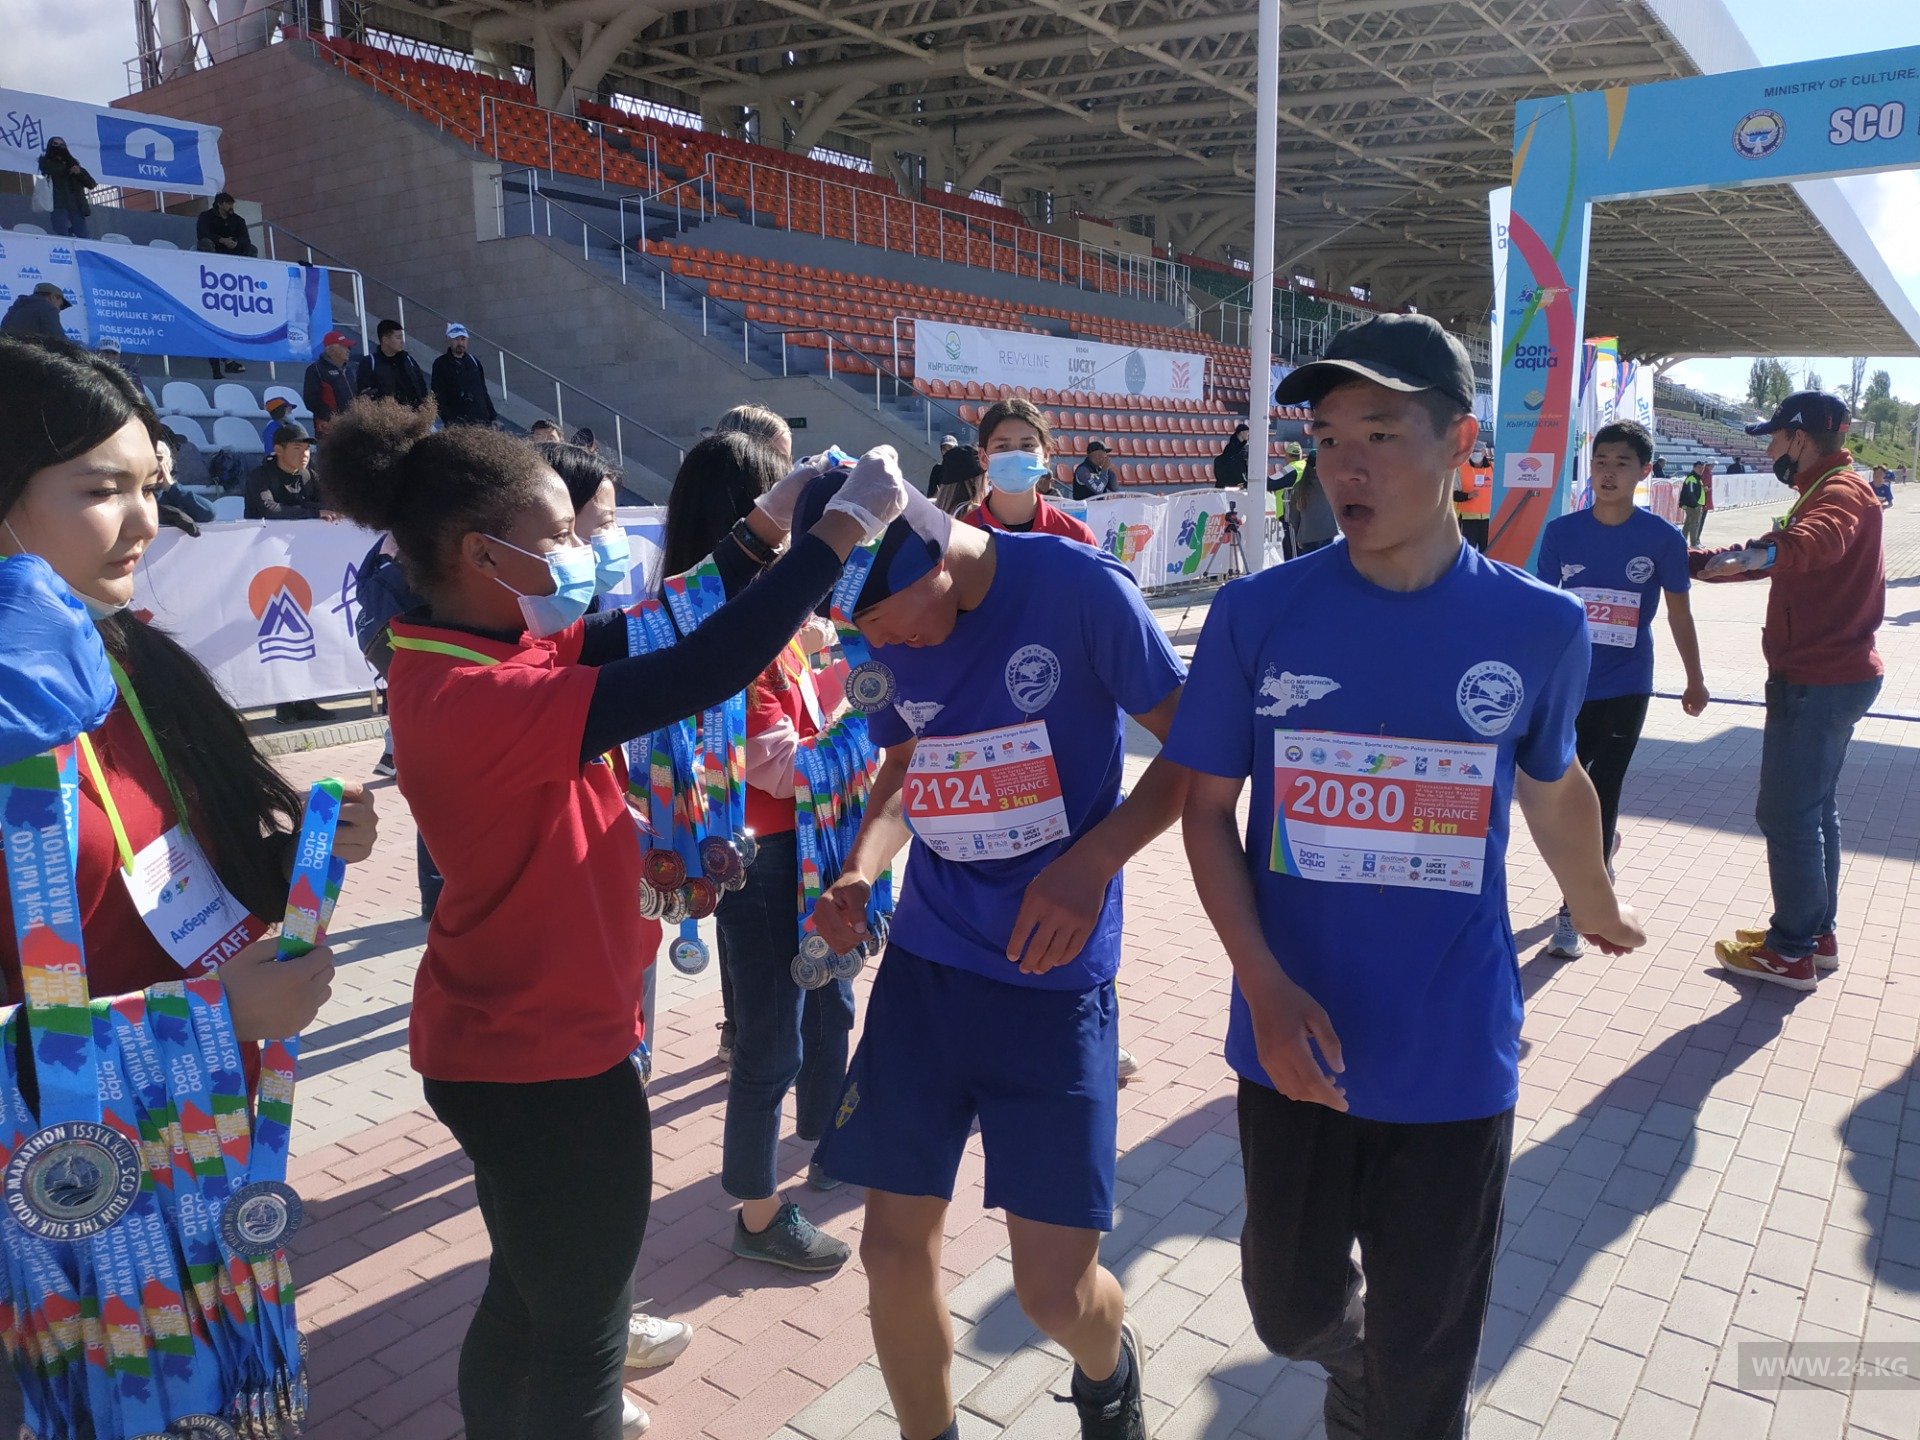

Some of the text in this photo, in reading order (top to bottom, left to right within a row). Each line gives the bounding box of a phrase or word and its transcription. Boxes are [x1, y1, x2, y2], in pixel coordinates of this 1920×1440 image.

[1764, 68, 1919, 98] MINISTRY OF CULTURE,
[1829, 100, 1905, 145] SCO
[138, 163, 167, 177] КТРК
[200, 265, 255, 293] bon
[92, 288, 142, 300] BONAQUA
[94, 298, 127, 309] МЕНЕН
[202, 291, 274, 317] aqua
[99, 324, 155, 336] ПОБЕЖДАЙ
[151, 313, 175, 323] ЖЕТ!
[999, 350, 1050, 368] REVYLINE
[1515, 343, 1550, 357] bon
[1068, 358, 1096, 373] LUCKY
[1514, 356, 1558, 371] aqua
[1068, 375, 1096, 390] SOCKS
[842, 567, 867, 613] MARATHON
[1585, 604, 1611, 620] 22
[910, 774, 991, 811] 2124
[996, 779, 1050, 797] DISTANCE
[1291, 775, 1405, 824] 2080
[999, 794, 1039, 810] 3 km
[1413, 806, 1479, 821] DISTANCE
[1411, 817, 1458, 834] 3 km
[312, 831, 329, 870] aqua
[1299, 857, 1326, 868] aqua
[11, 830, 48, 930] Issyk Kul SCO
[41, 824, 74, 925] MARATHON
[170, 897, 226, 944] Акбермет
[201, 925, 250, 972] STAFF
[193, 1006, 221, 1073] MARATHON
[116, 1025, 150, 1090] MARATHON
[222, 1048, 237, 1070] SCO
[102, 1060, 123, 1100] aqua
[148, 1065, 166, 1083] SCO
[182, 1053, 202, 1092] aqua
[7, 1124, 136, 1238] MARATHON ISSYK KUL SCO RUN THE SILK ROAD
[127, 1217, 144, 1239] SCO
[145, 1212, 173, 1279] MARATHON
[111, 1226, 134, 1295] MARATHON
